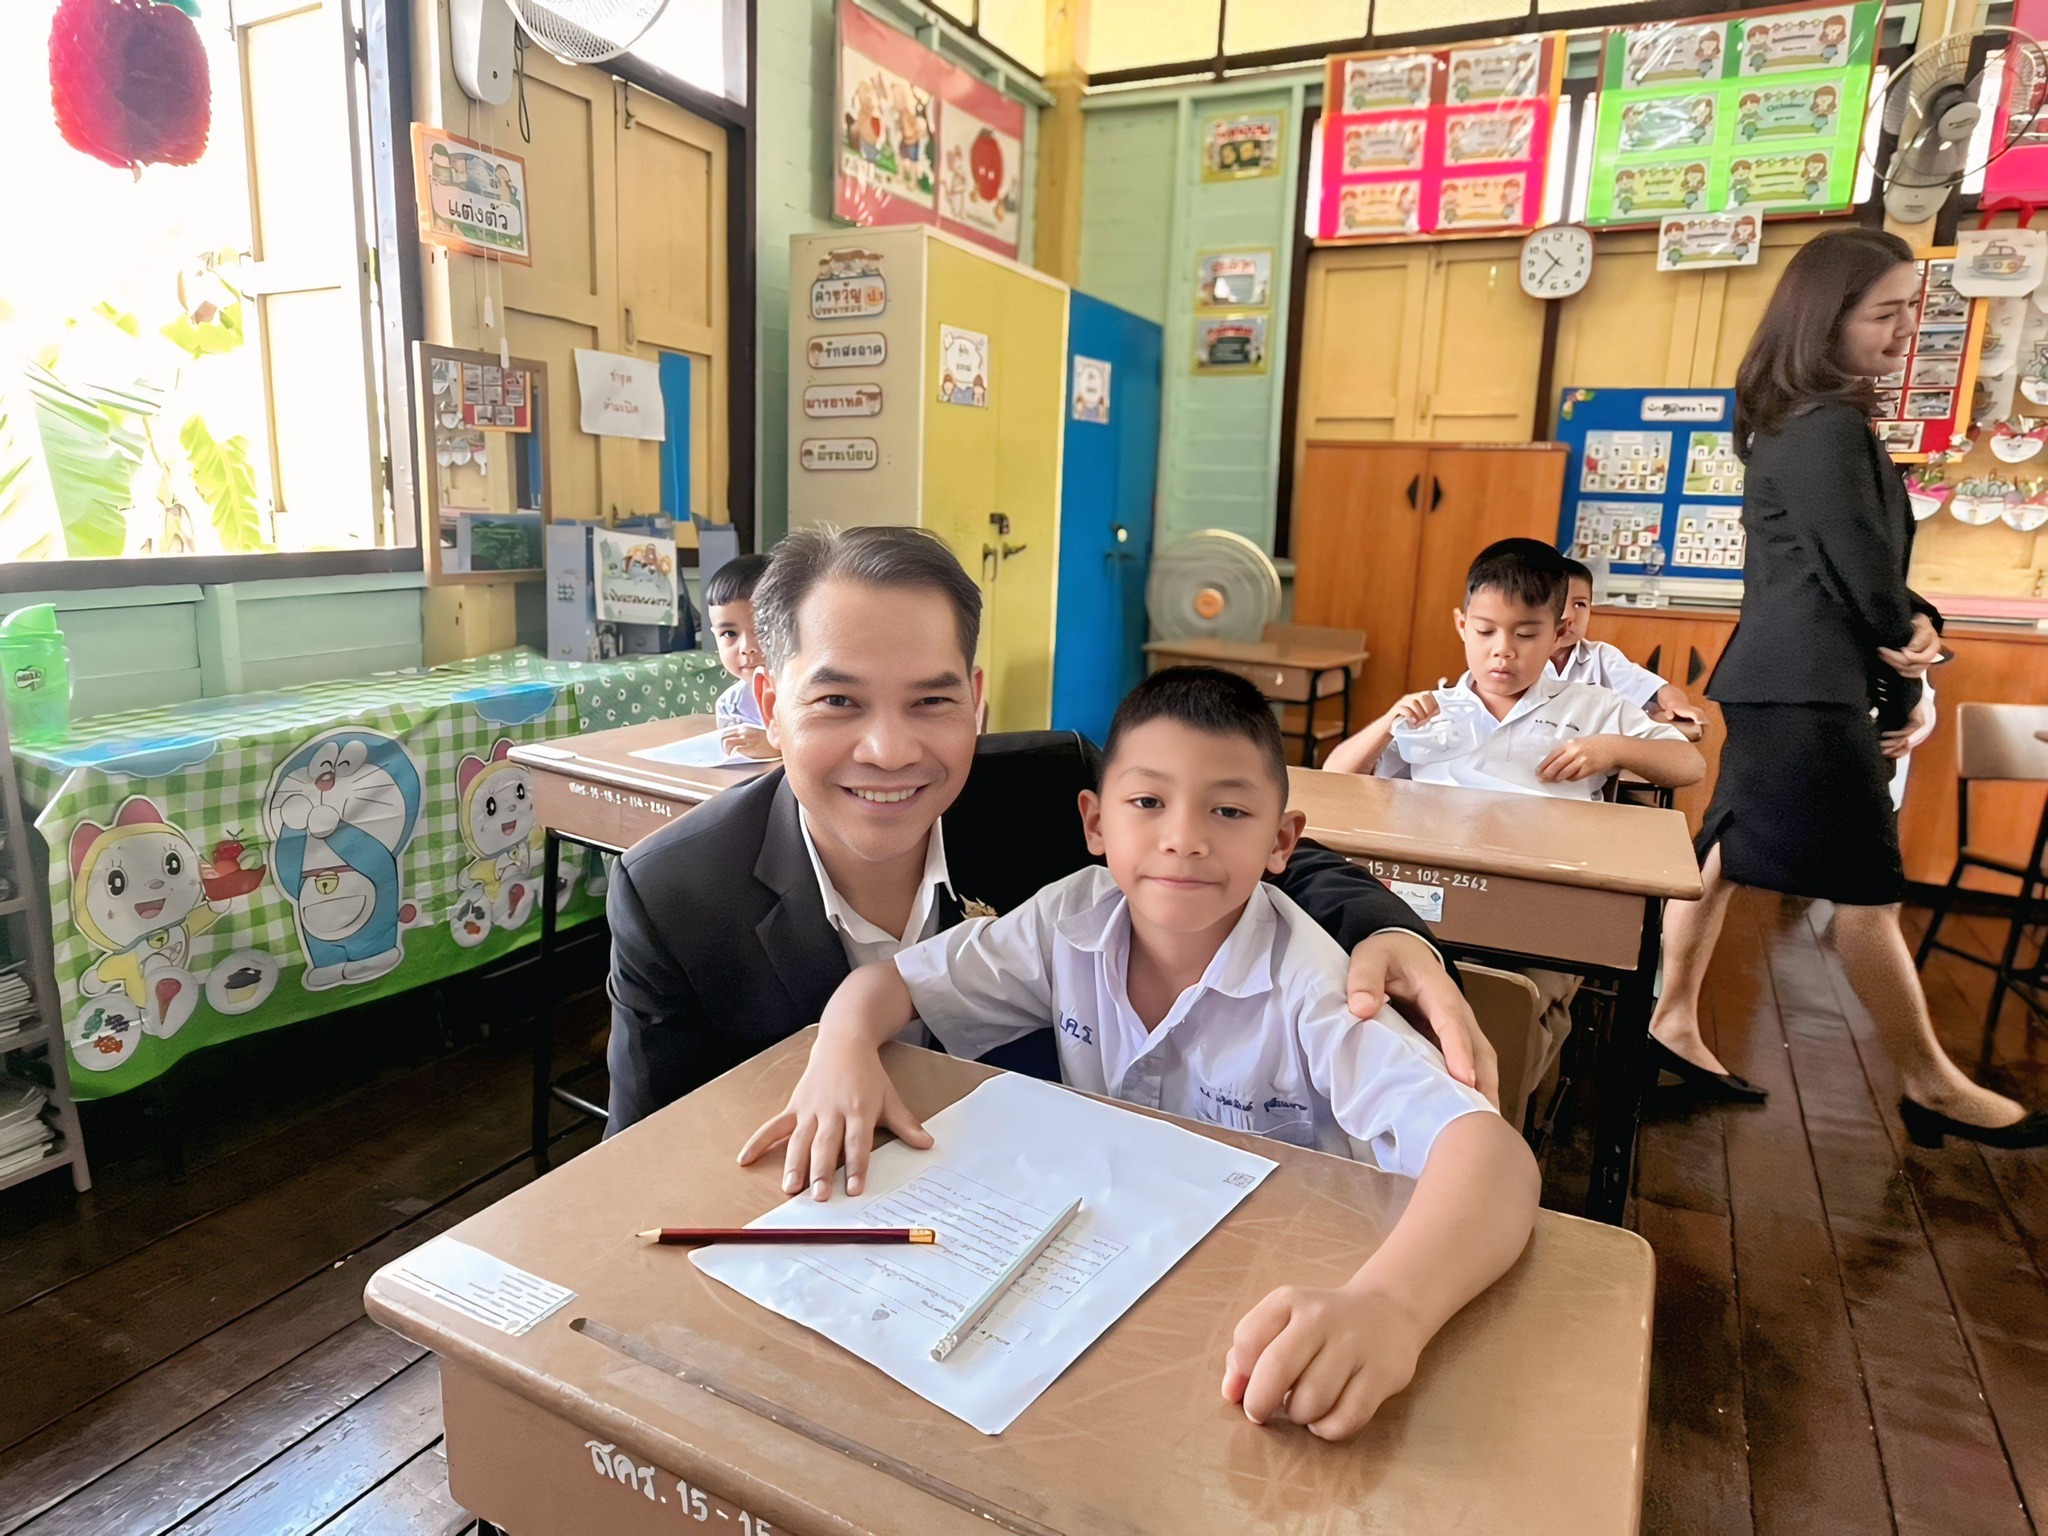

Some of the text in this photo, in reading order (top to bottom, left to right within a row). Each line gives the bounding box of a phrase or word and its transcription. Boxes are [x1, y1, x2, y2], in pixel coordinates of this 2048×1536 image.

[448, 197, 508, 231] แต่งตัว
[1552, 232, 1564, 242] 12
[1576, 243, 1584, 252] 2
[1550, 281, 1558, 291] 6
[1563, 280, 1571, 289] 5
